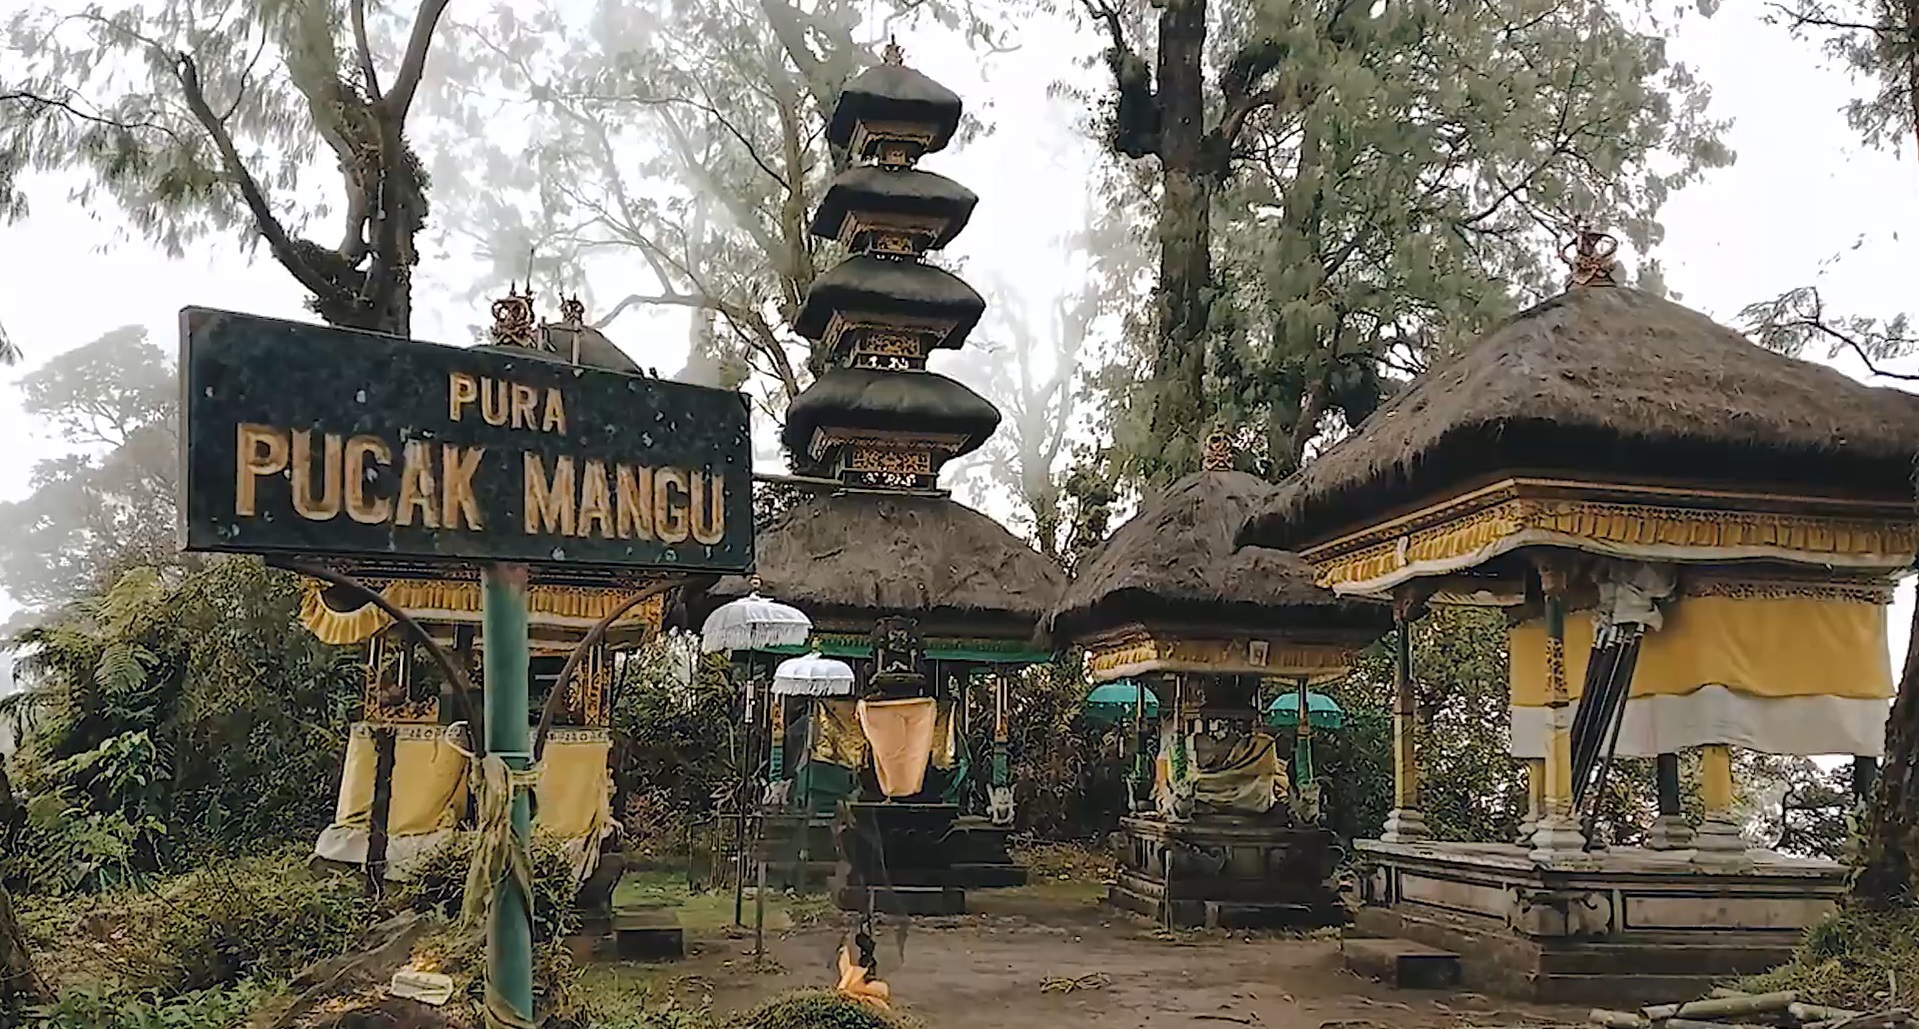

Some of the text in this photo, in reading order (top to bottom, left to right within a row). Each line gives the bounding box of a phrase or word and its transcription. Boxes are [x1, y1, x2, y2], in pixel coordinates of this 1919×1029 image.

[447, 372, 568, 434] PURA
[235, 422, 726, 547] PUCAK MANGU
